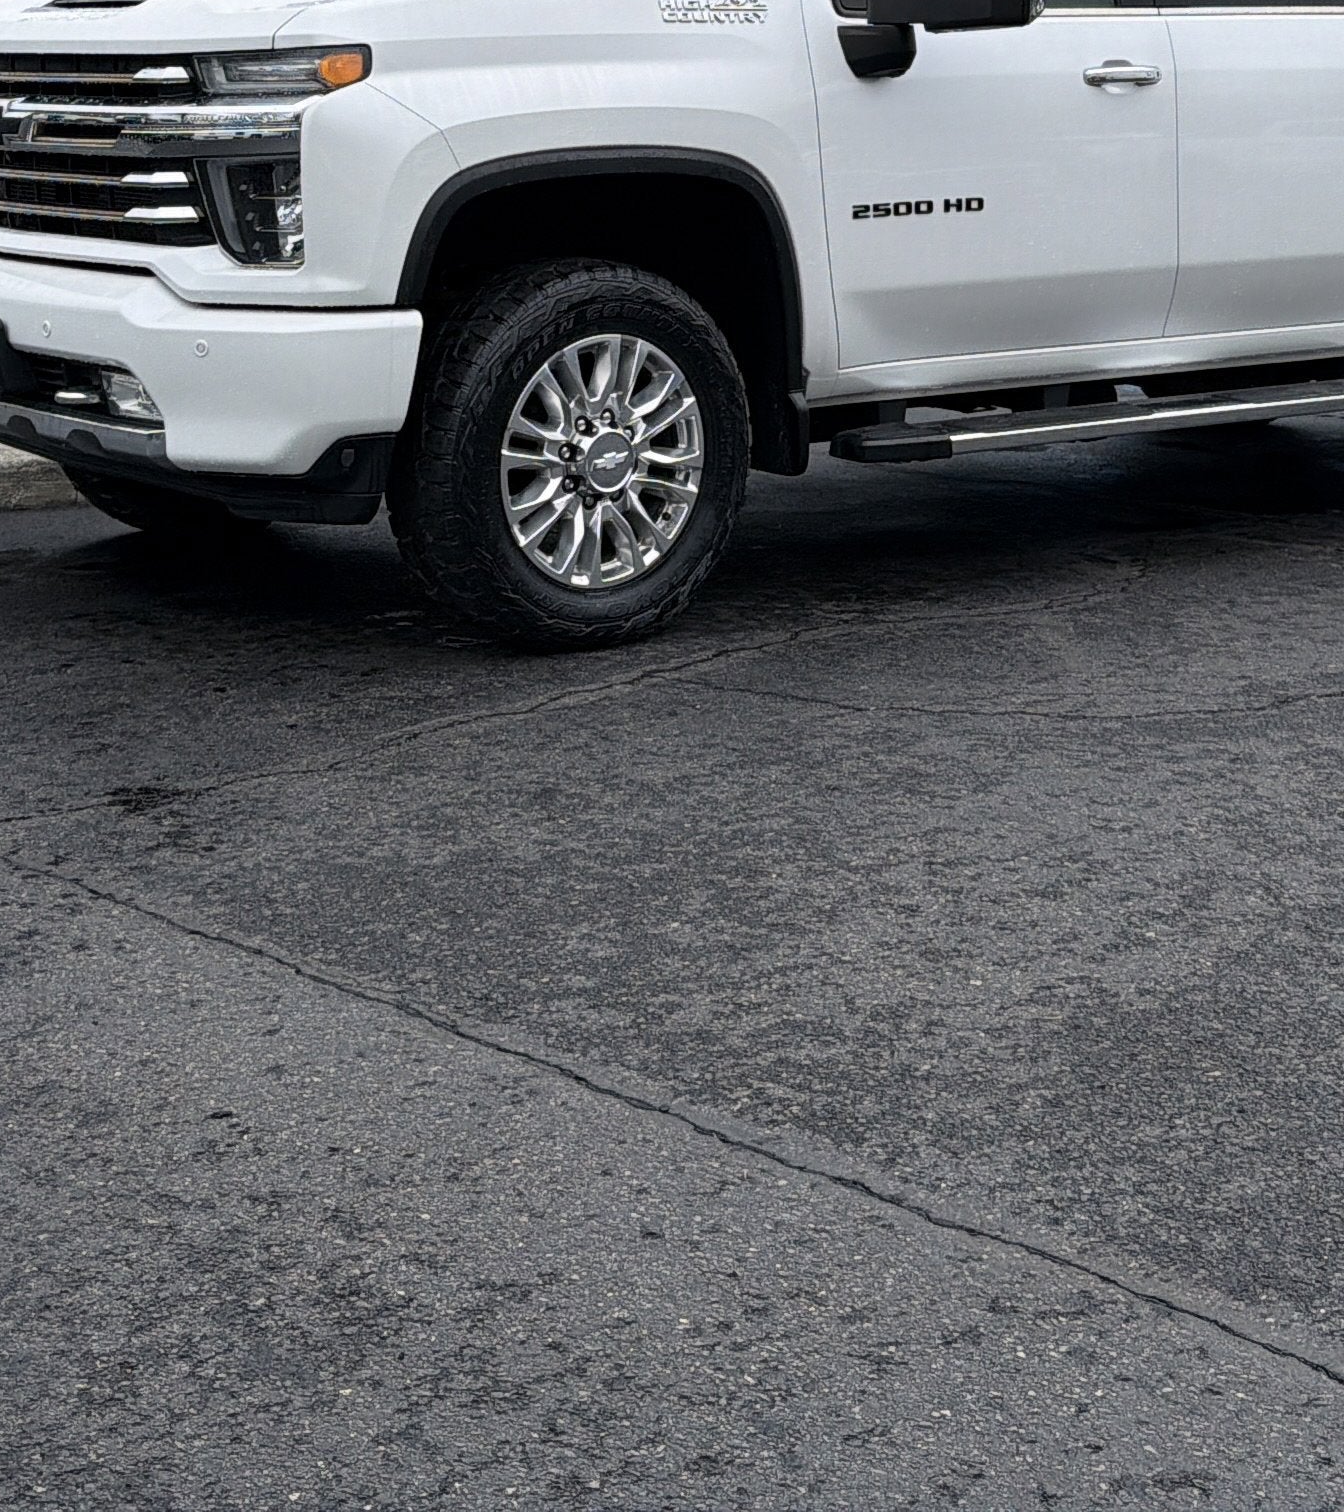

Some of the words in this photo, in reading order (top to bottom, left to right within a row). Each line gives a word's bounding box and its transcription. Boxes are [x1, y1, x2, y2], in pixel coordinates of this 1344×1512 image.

[657, 0, 714, 11] HIGH
[661, 11, 768, 24] COUNTRY
[852, 200, 934, 220] 2500
[943, 197, 984, 213] HD
